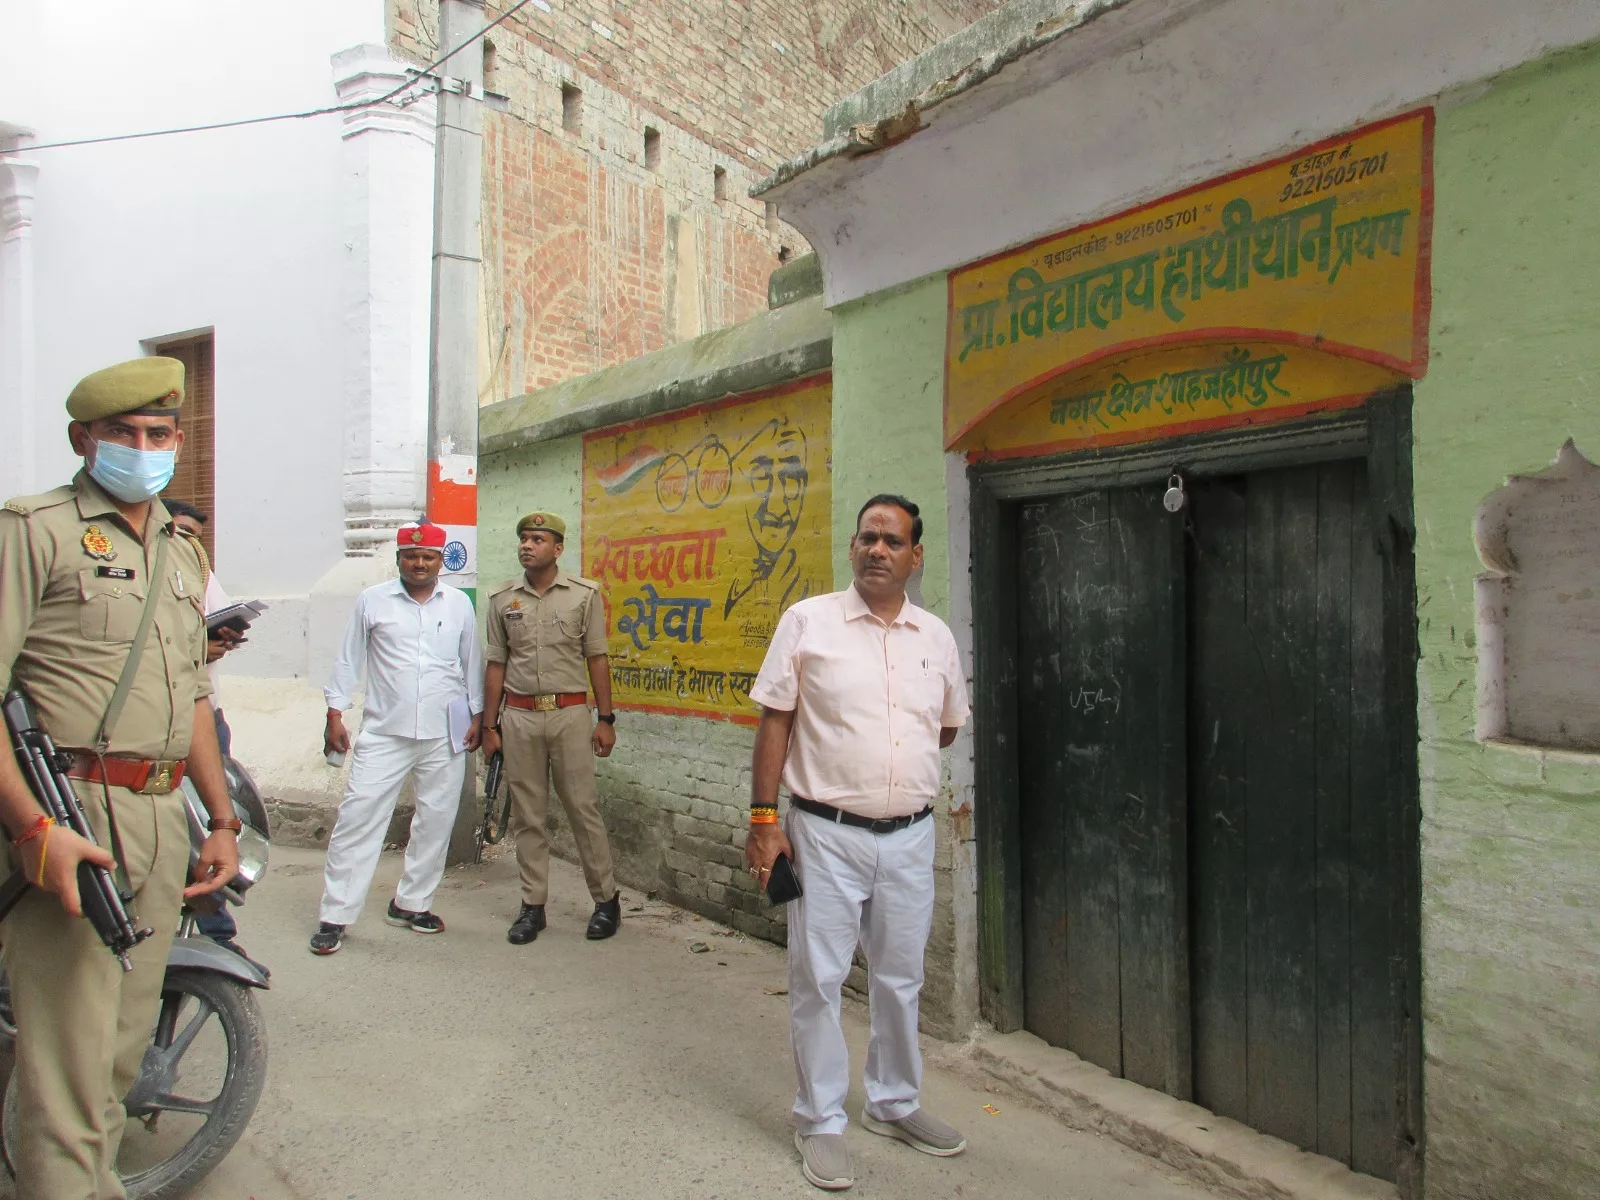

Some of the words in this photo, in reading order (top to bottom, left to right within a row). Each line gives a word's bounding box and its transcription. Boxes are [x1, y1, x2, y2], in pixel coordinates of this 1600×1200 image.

[1279, 152, 1389, 203] 9221505701
[1115, 206, 1198, 246] 9221505701
[1160, 196, 1338, 324] हाथीथान
[1328, 209, 1410, 284] प्रथम
[1048, 389, 1110, 428] नगर
[1107, 372, 1158, 422] क्षेत्र
[591, 528, 727, 590] स्वच्छता
[617, 583, 712, 651] सेवा
[688, 666, 726, 703] भारत
[729, 672, 760, 706] स्व
